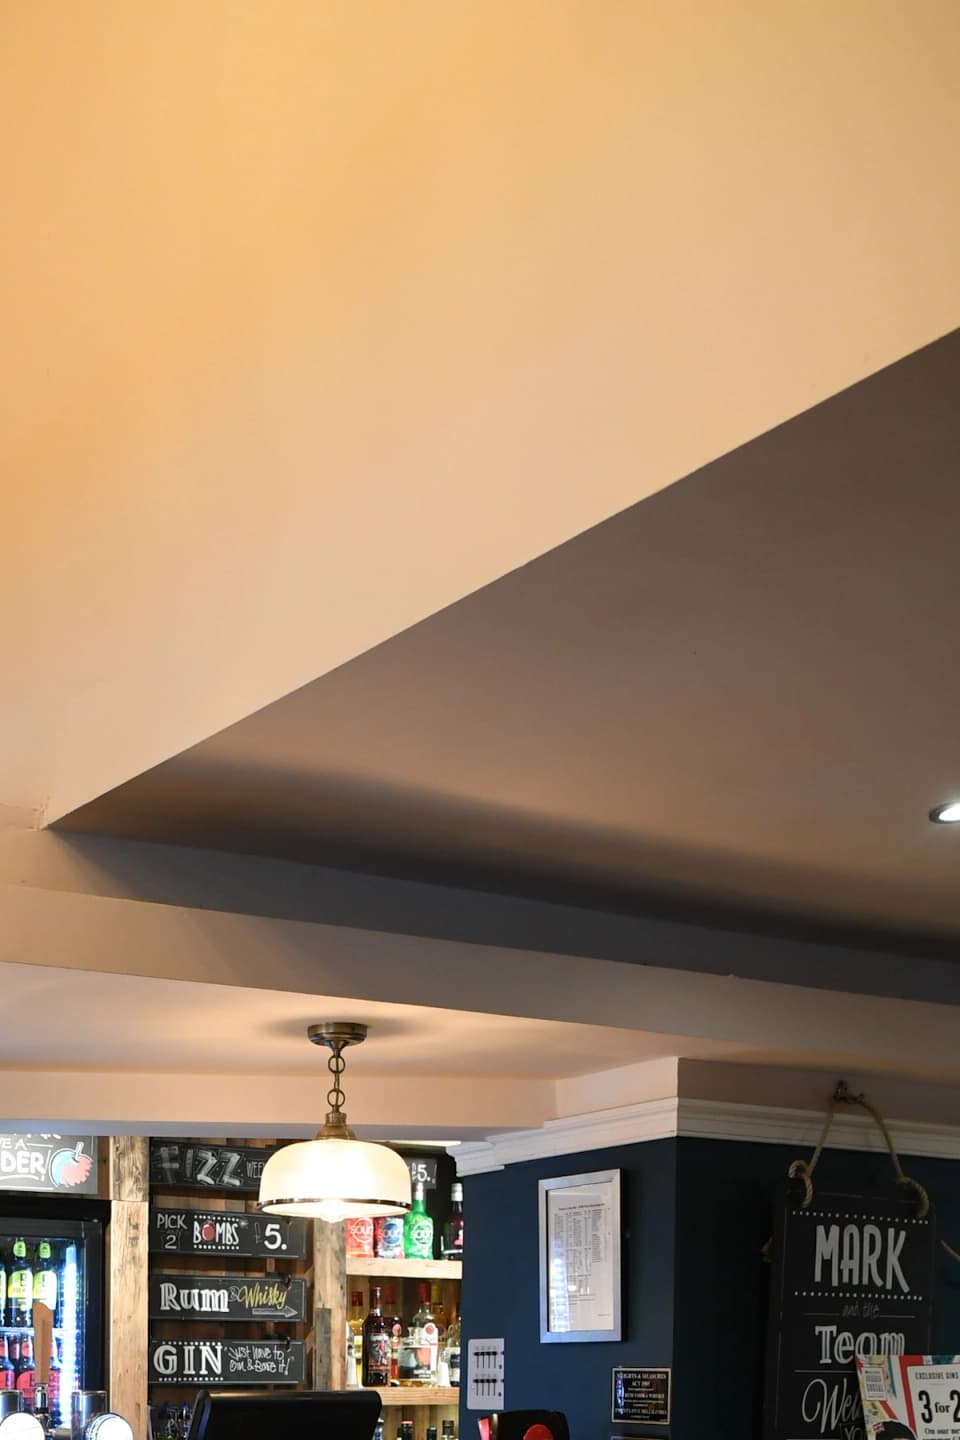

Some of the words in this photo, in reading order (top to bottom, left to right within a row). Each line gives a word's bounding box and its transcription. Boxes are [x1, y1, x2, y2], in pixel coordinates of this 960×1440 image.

[15, 1138, 28, 1150] A
[246, 1161, 266, 1178] WEE
[156, 1213, 188, 1230] PICK
[193, 1220, 240, 1245] BOMBS
[164, 1235, 177, 1249] 2
[814, 1223, 910, 1294] MARK
[159, 1282, 230, 1313] Rum
[237, 1282, 288, 1310] Whisky
[814, 1325, 906, 1364] Team
[153, 1344, 223, 1375] GIN
[918, 1389, 934, 1424] 3
[934, 1402, 951, 1414] for
